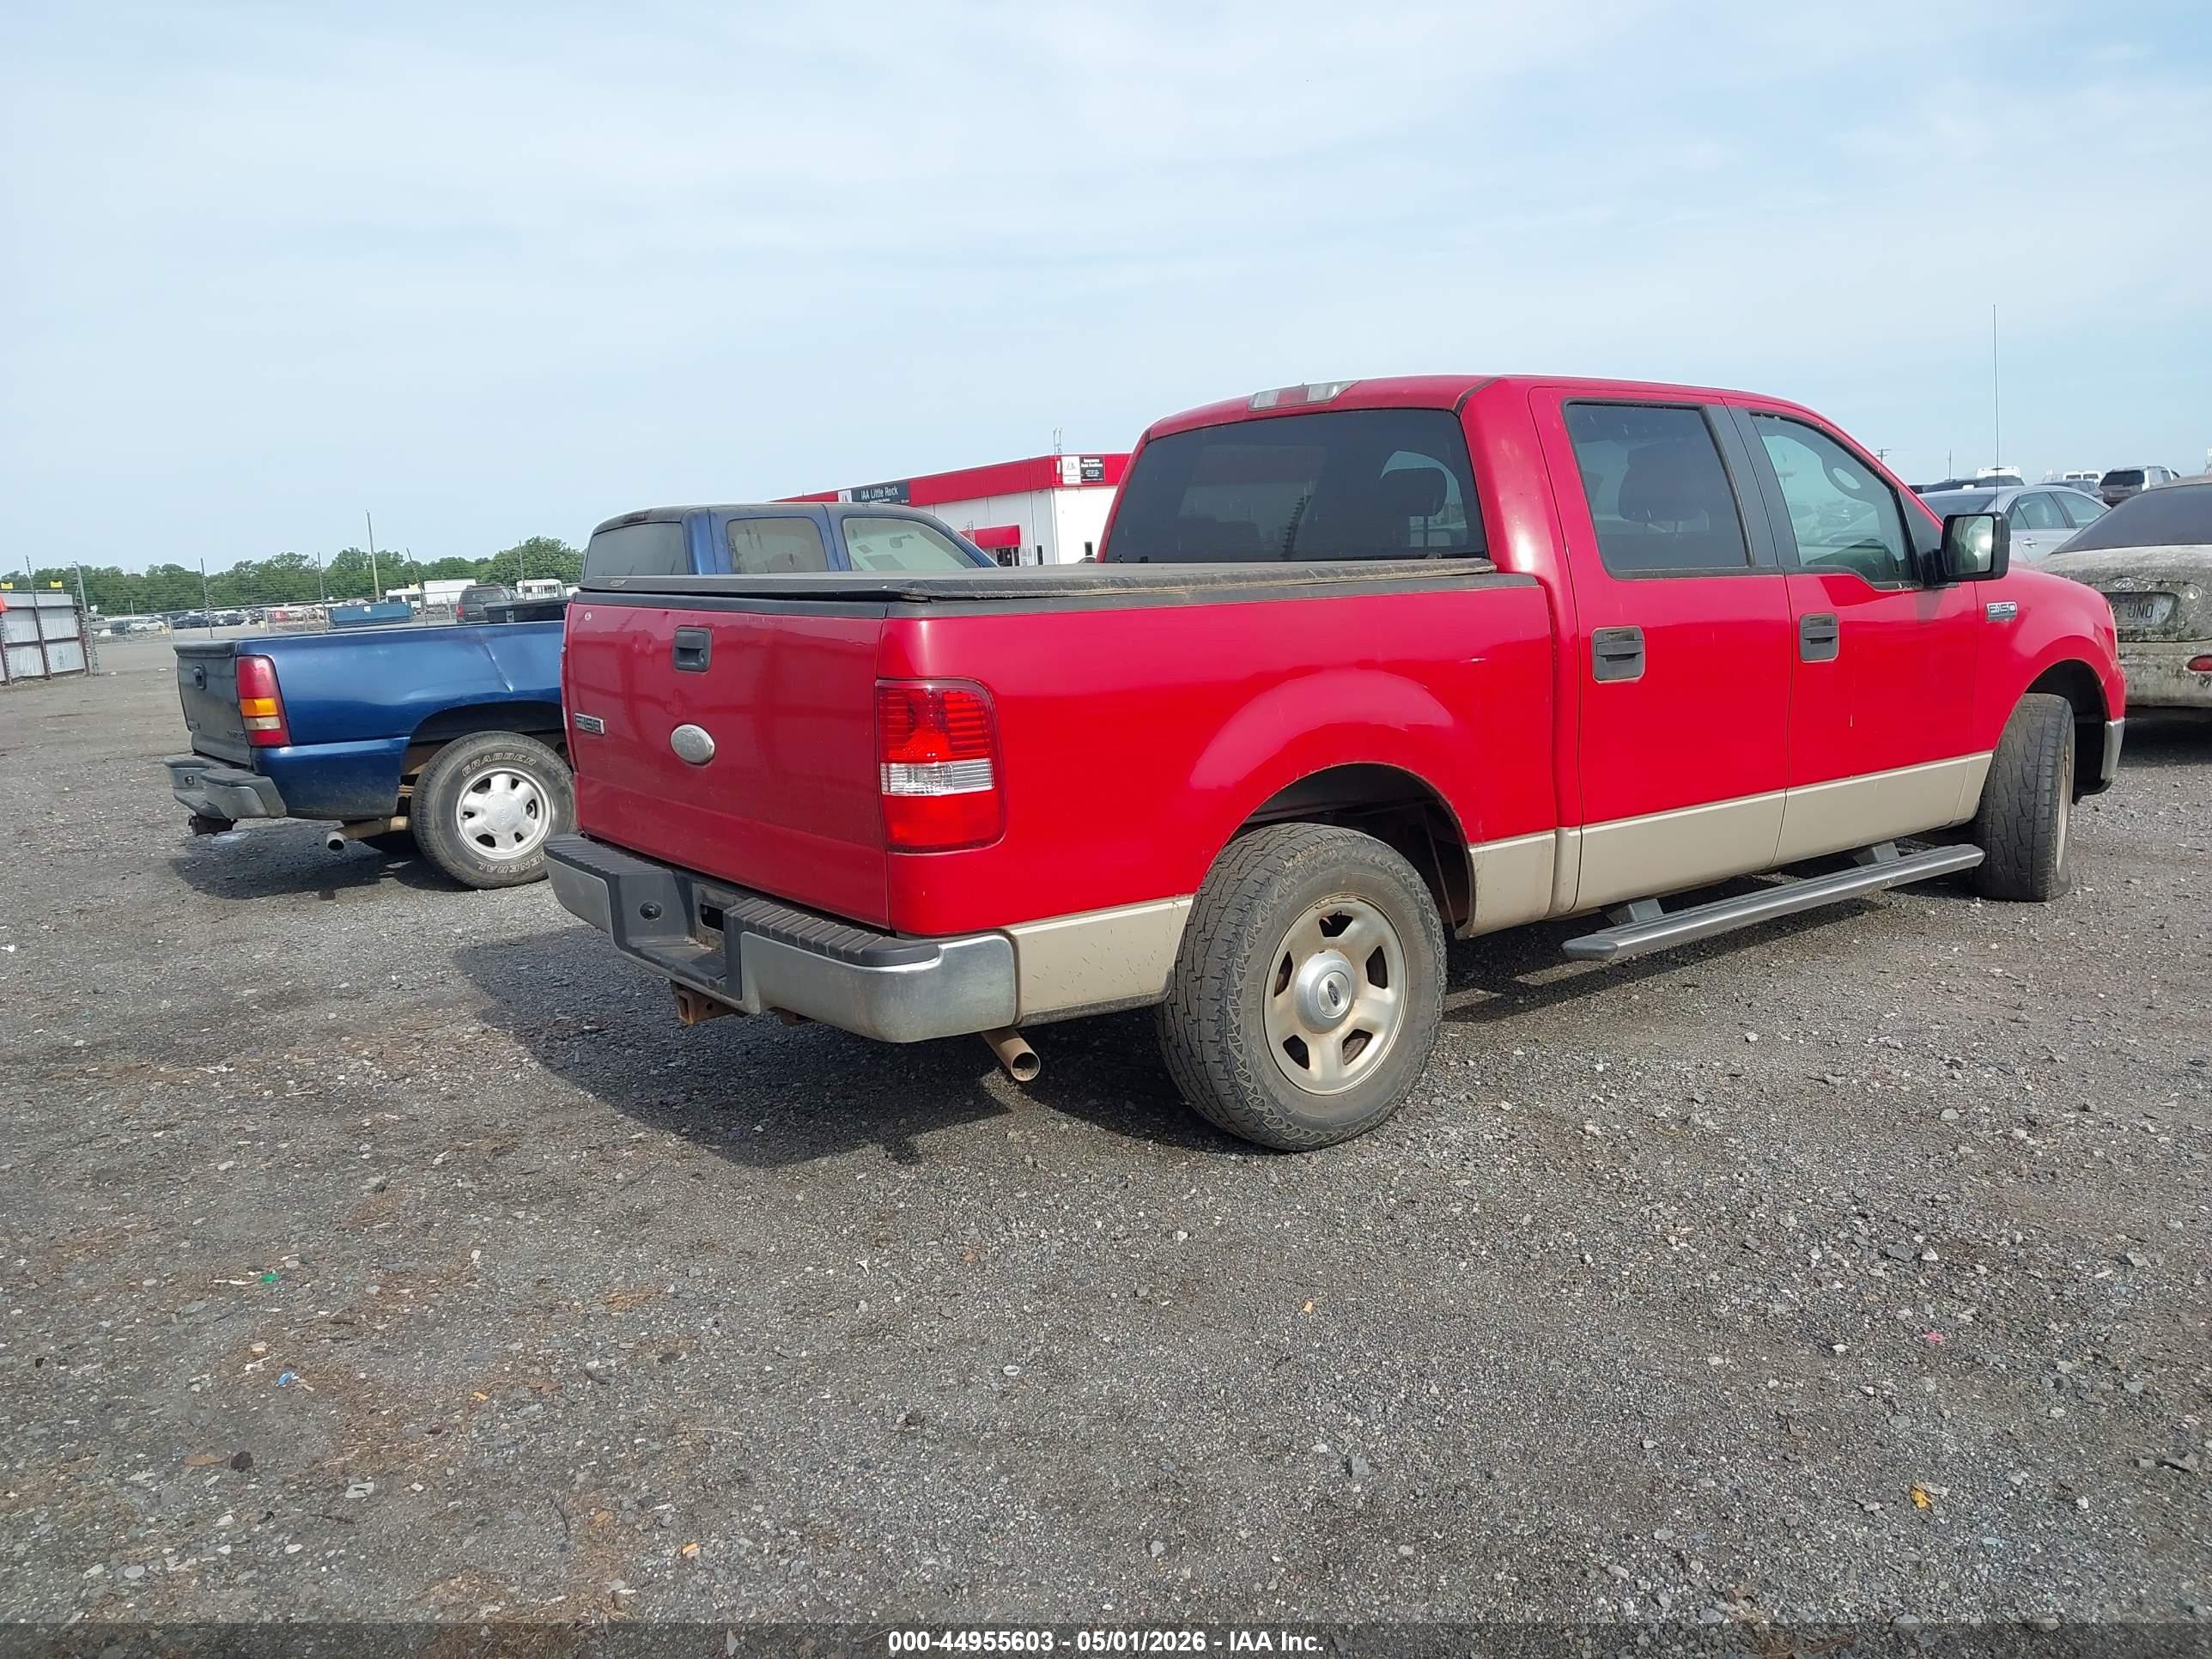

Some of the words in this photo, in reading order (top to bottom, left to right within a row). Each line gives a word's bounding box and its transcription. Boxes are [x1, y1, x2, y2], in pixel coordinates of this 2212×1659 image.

[871, 487, 884, 499] Little
[884, 485, 899, 497] Rock
[462, 752, 536, 776] GRABBER
